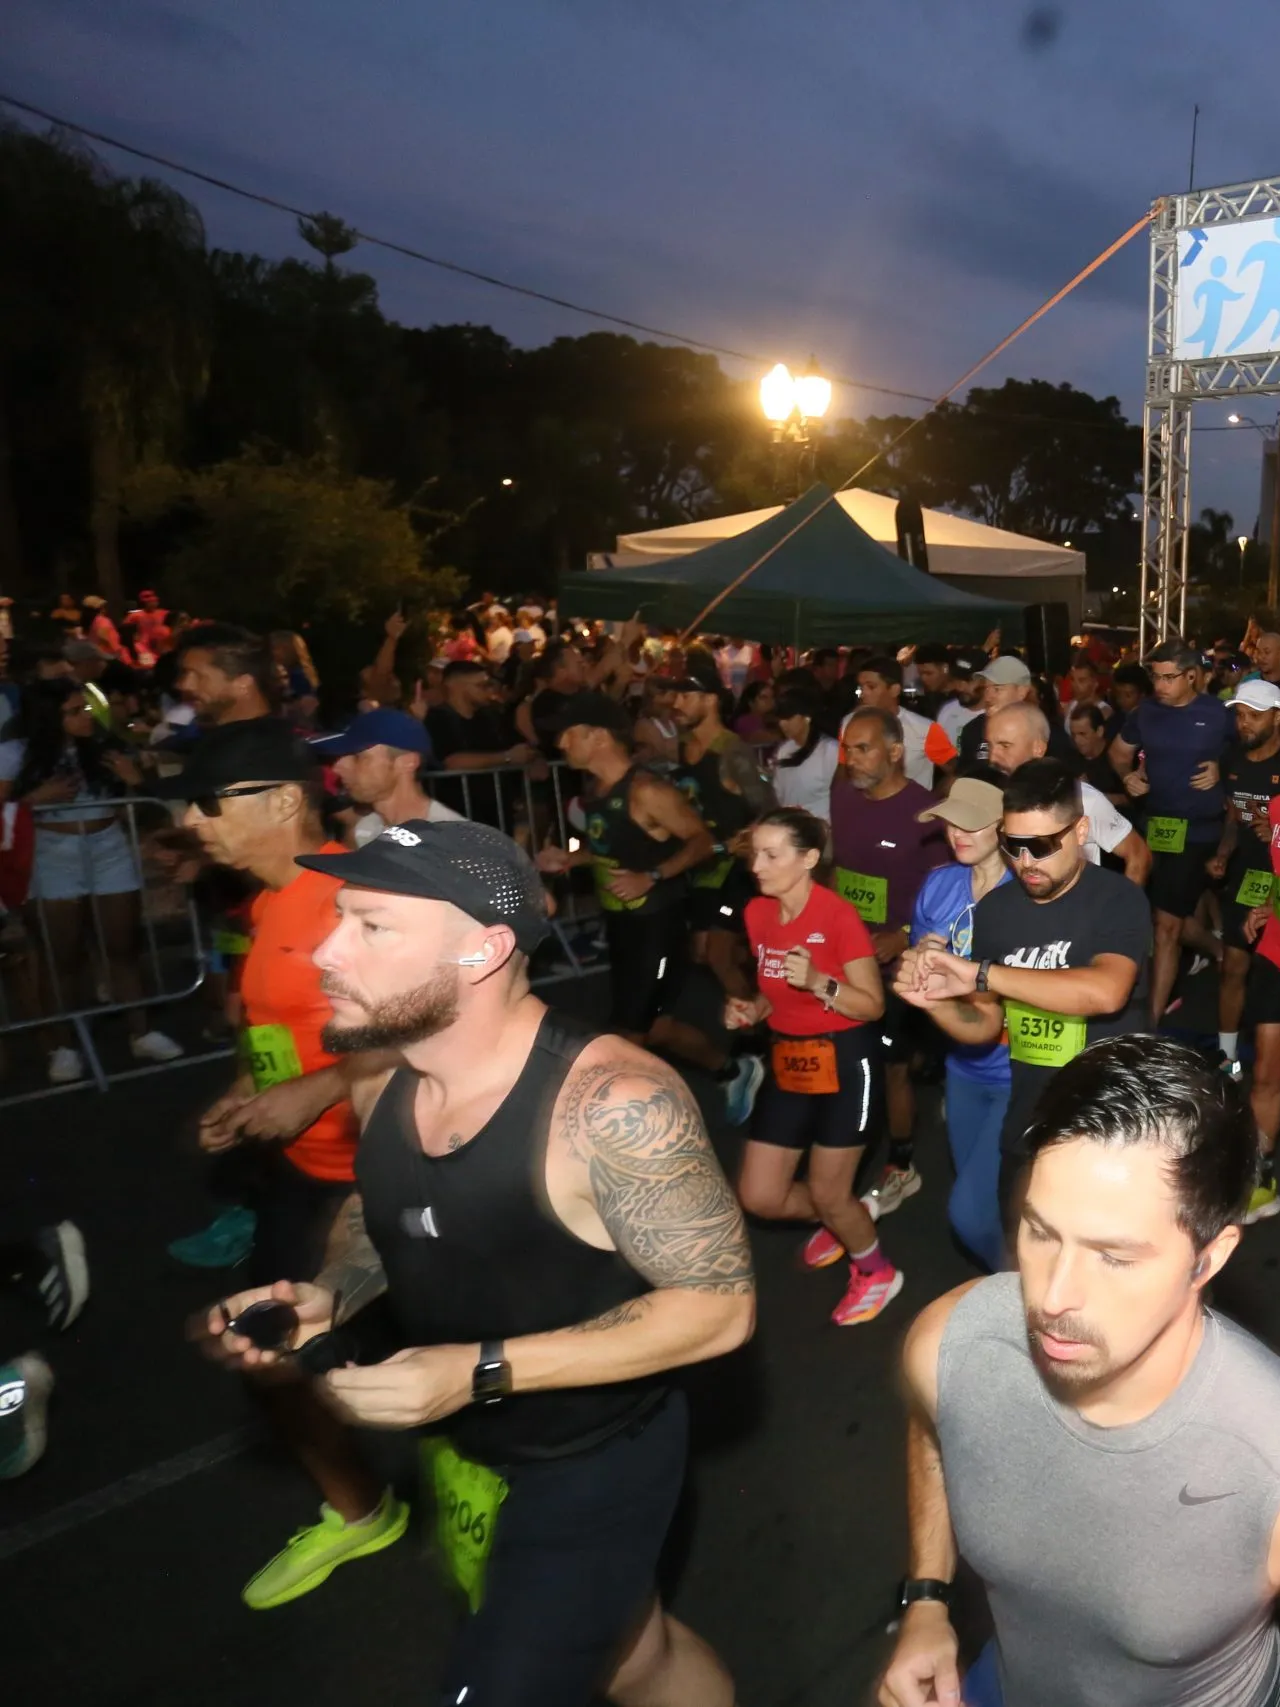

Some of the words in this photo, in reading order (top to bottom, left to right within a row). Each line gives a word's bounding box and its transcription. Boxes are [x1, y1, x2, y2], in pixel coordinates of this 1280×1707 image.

[843, 885, 876, 905] 4679
[1019, 1016, 1065, 1039] 5319
[1020, 1040, 1063, 1052] LEONARDO
